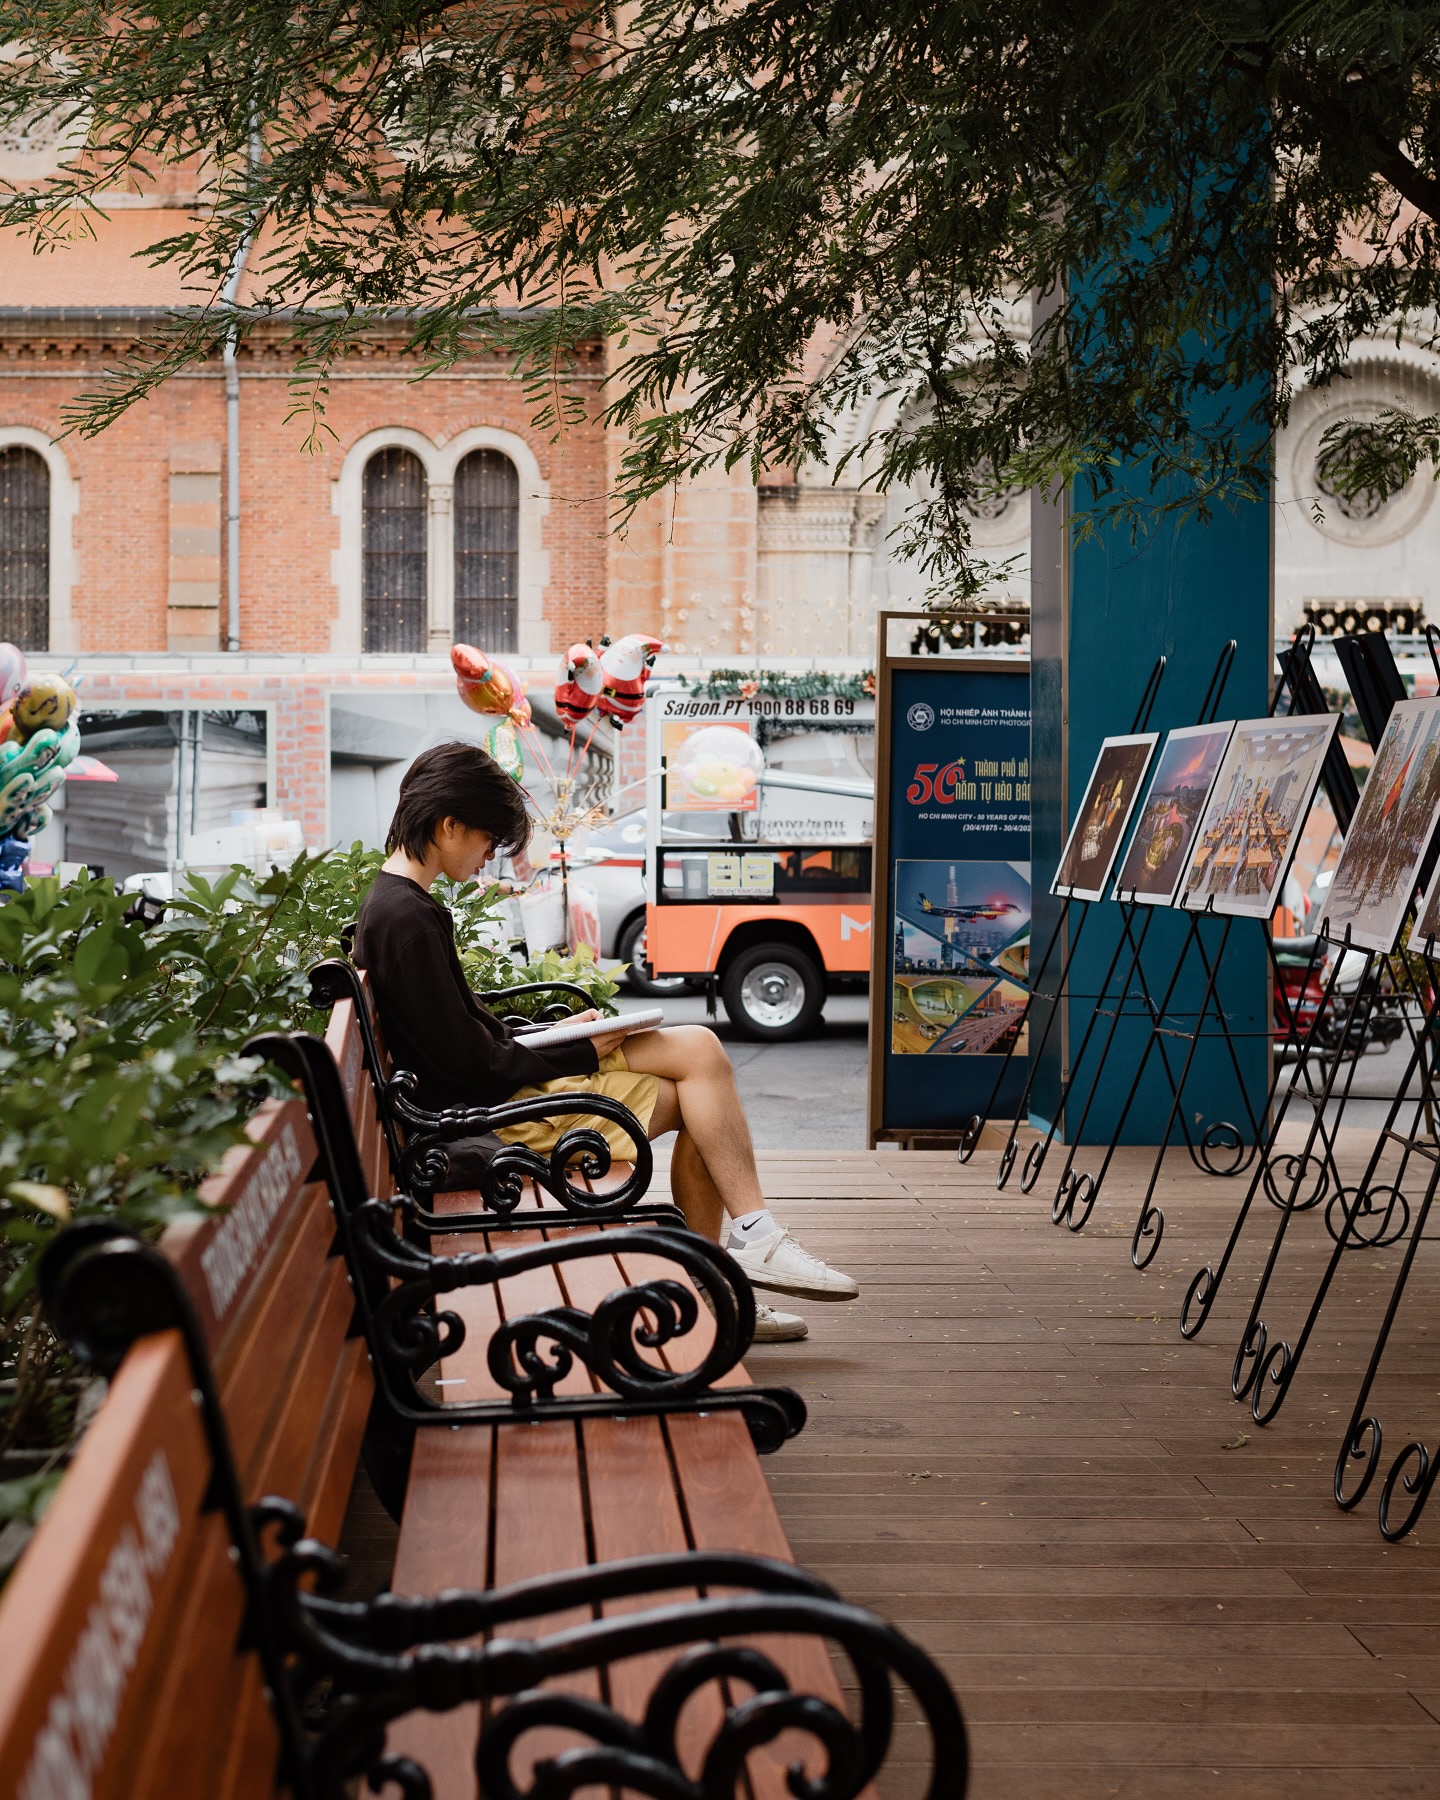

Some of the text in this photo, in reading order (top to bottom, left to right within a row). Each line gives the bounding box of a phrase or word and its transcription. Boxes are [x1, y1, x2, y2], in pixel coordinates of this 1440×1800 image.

[664, 699, 855, 718] Saigon.PT 1900 88 68 69
[974, 757, 1029, 777] THÀNH PHỐ HỒ
[955, 780, 977, 801] NĂM
[980, 782, 992, 804] TỰ
[994, 781, 1012, 801] HÀO
[963, 824, 998, 832] (30/4/1975
